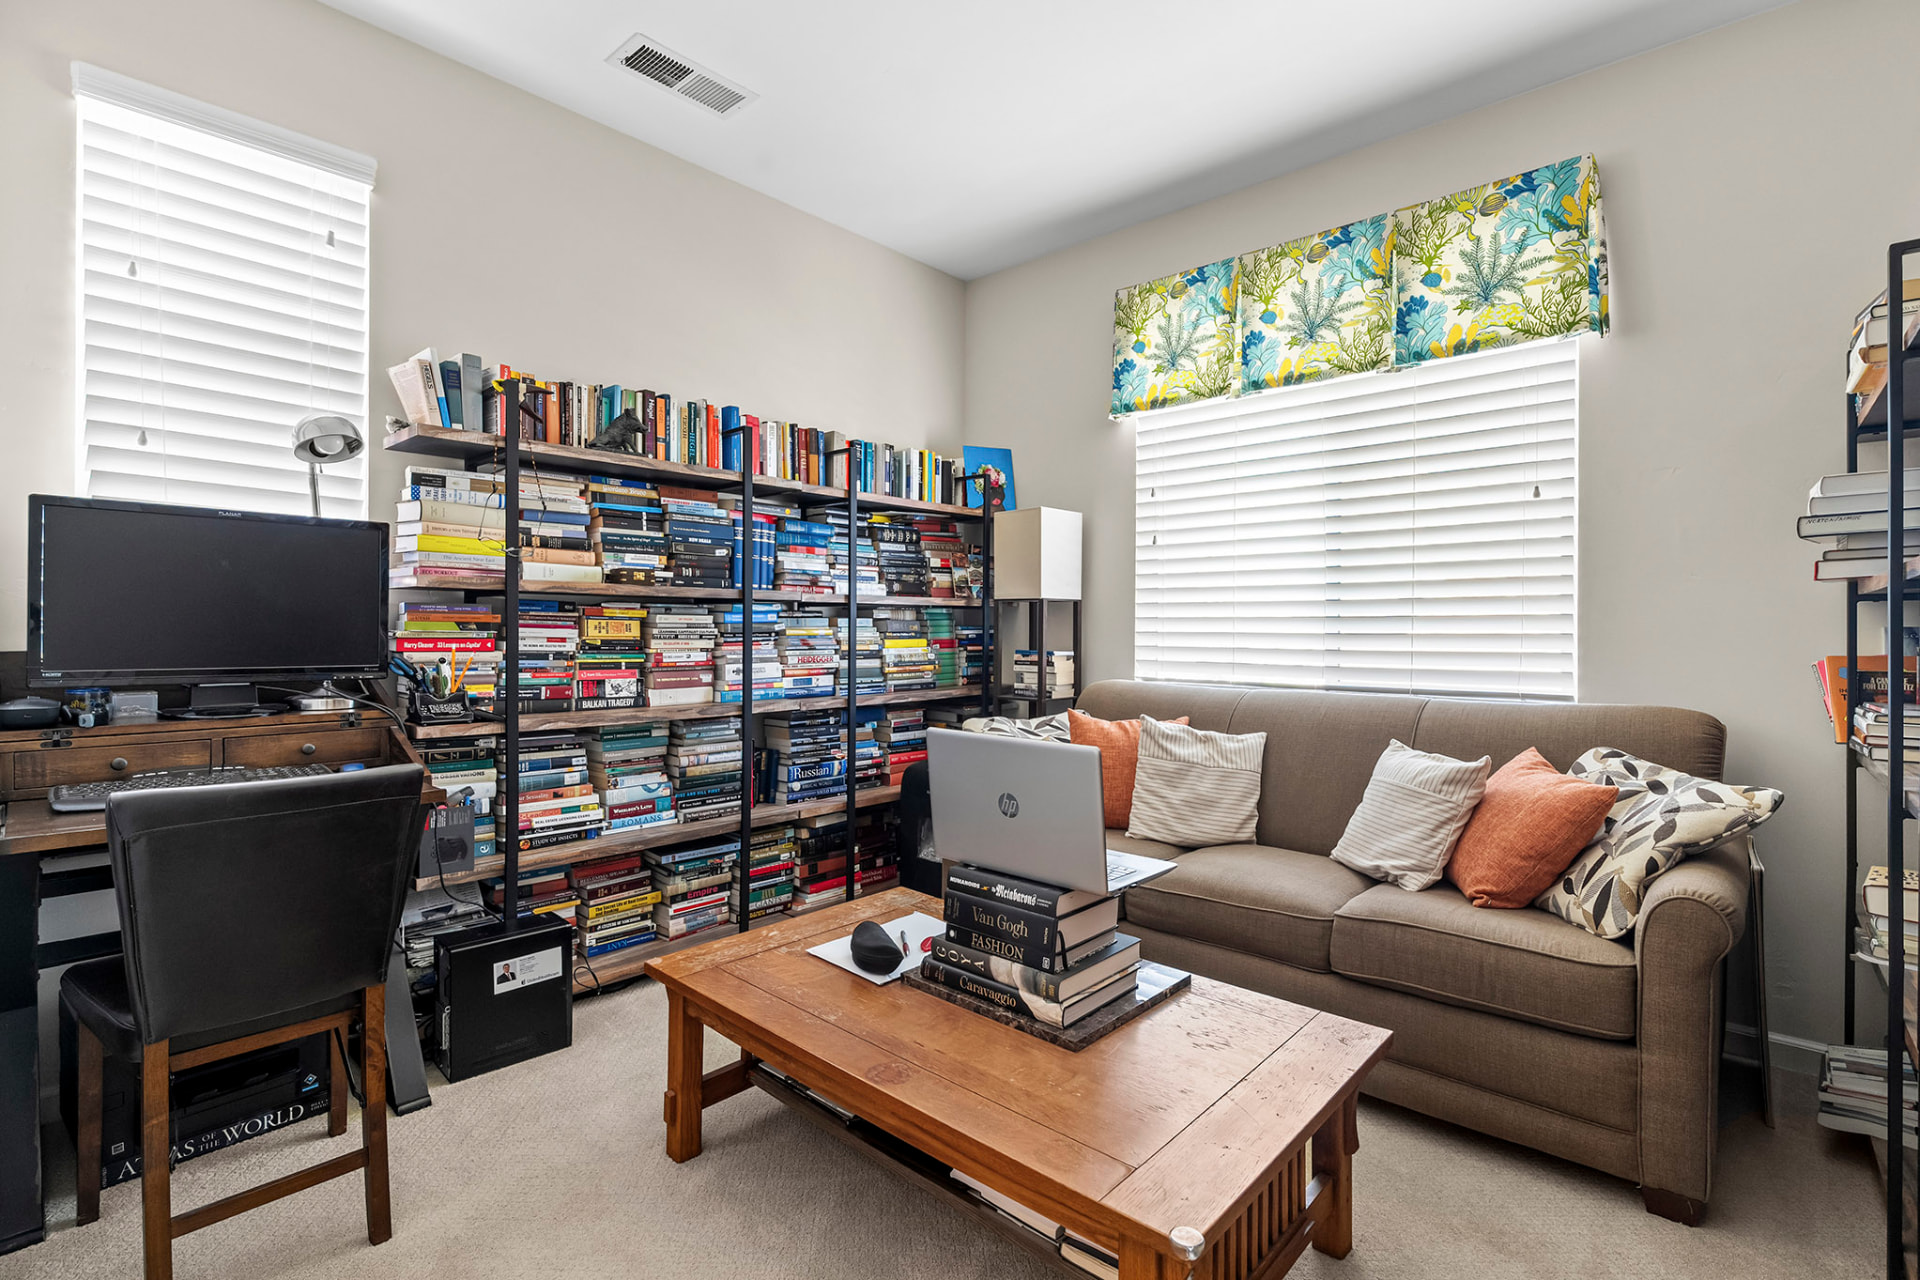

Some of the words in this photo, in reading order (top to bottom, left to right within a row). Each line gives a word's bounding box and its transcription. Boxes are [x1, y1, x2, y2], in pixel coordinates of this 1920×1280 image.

[647, 398, 655, 420] Hegel
[404, 641, 417, 649] Harry
[797, 655, 833, 664] HEIDEGGER
[1863, 682, 1875, 690] FOR
[582, 700, 607, 709] BALKAN
[608, 698, 635, 707] TRAGEDY
[794, 765, 829, 780] Russian
[621, 814, 662, 827] ROMANS
[531, 838, 549, 846] STUDY
[557, 833, 578, 842] INSECTS
[610, 869, 628, 877] SPEAKS
[687, 886, 719, 899] Empire
[972, 905, 994, 927] Van
[997, 914, 1028, 939] Gogh
[971, 932, 1024, 960] FASHION
[936, 945, 984, 973] GOYA
[960, 975, 1016, 1008] Caravaggio
[118, 1139, 195, 1180] AAS
[201, 1131, 217, 1142] OF
[221, 1104, 305, 1143] WORLD
